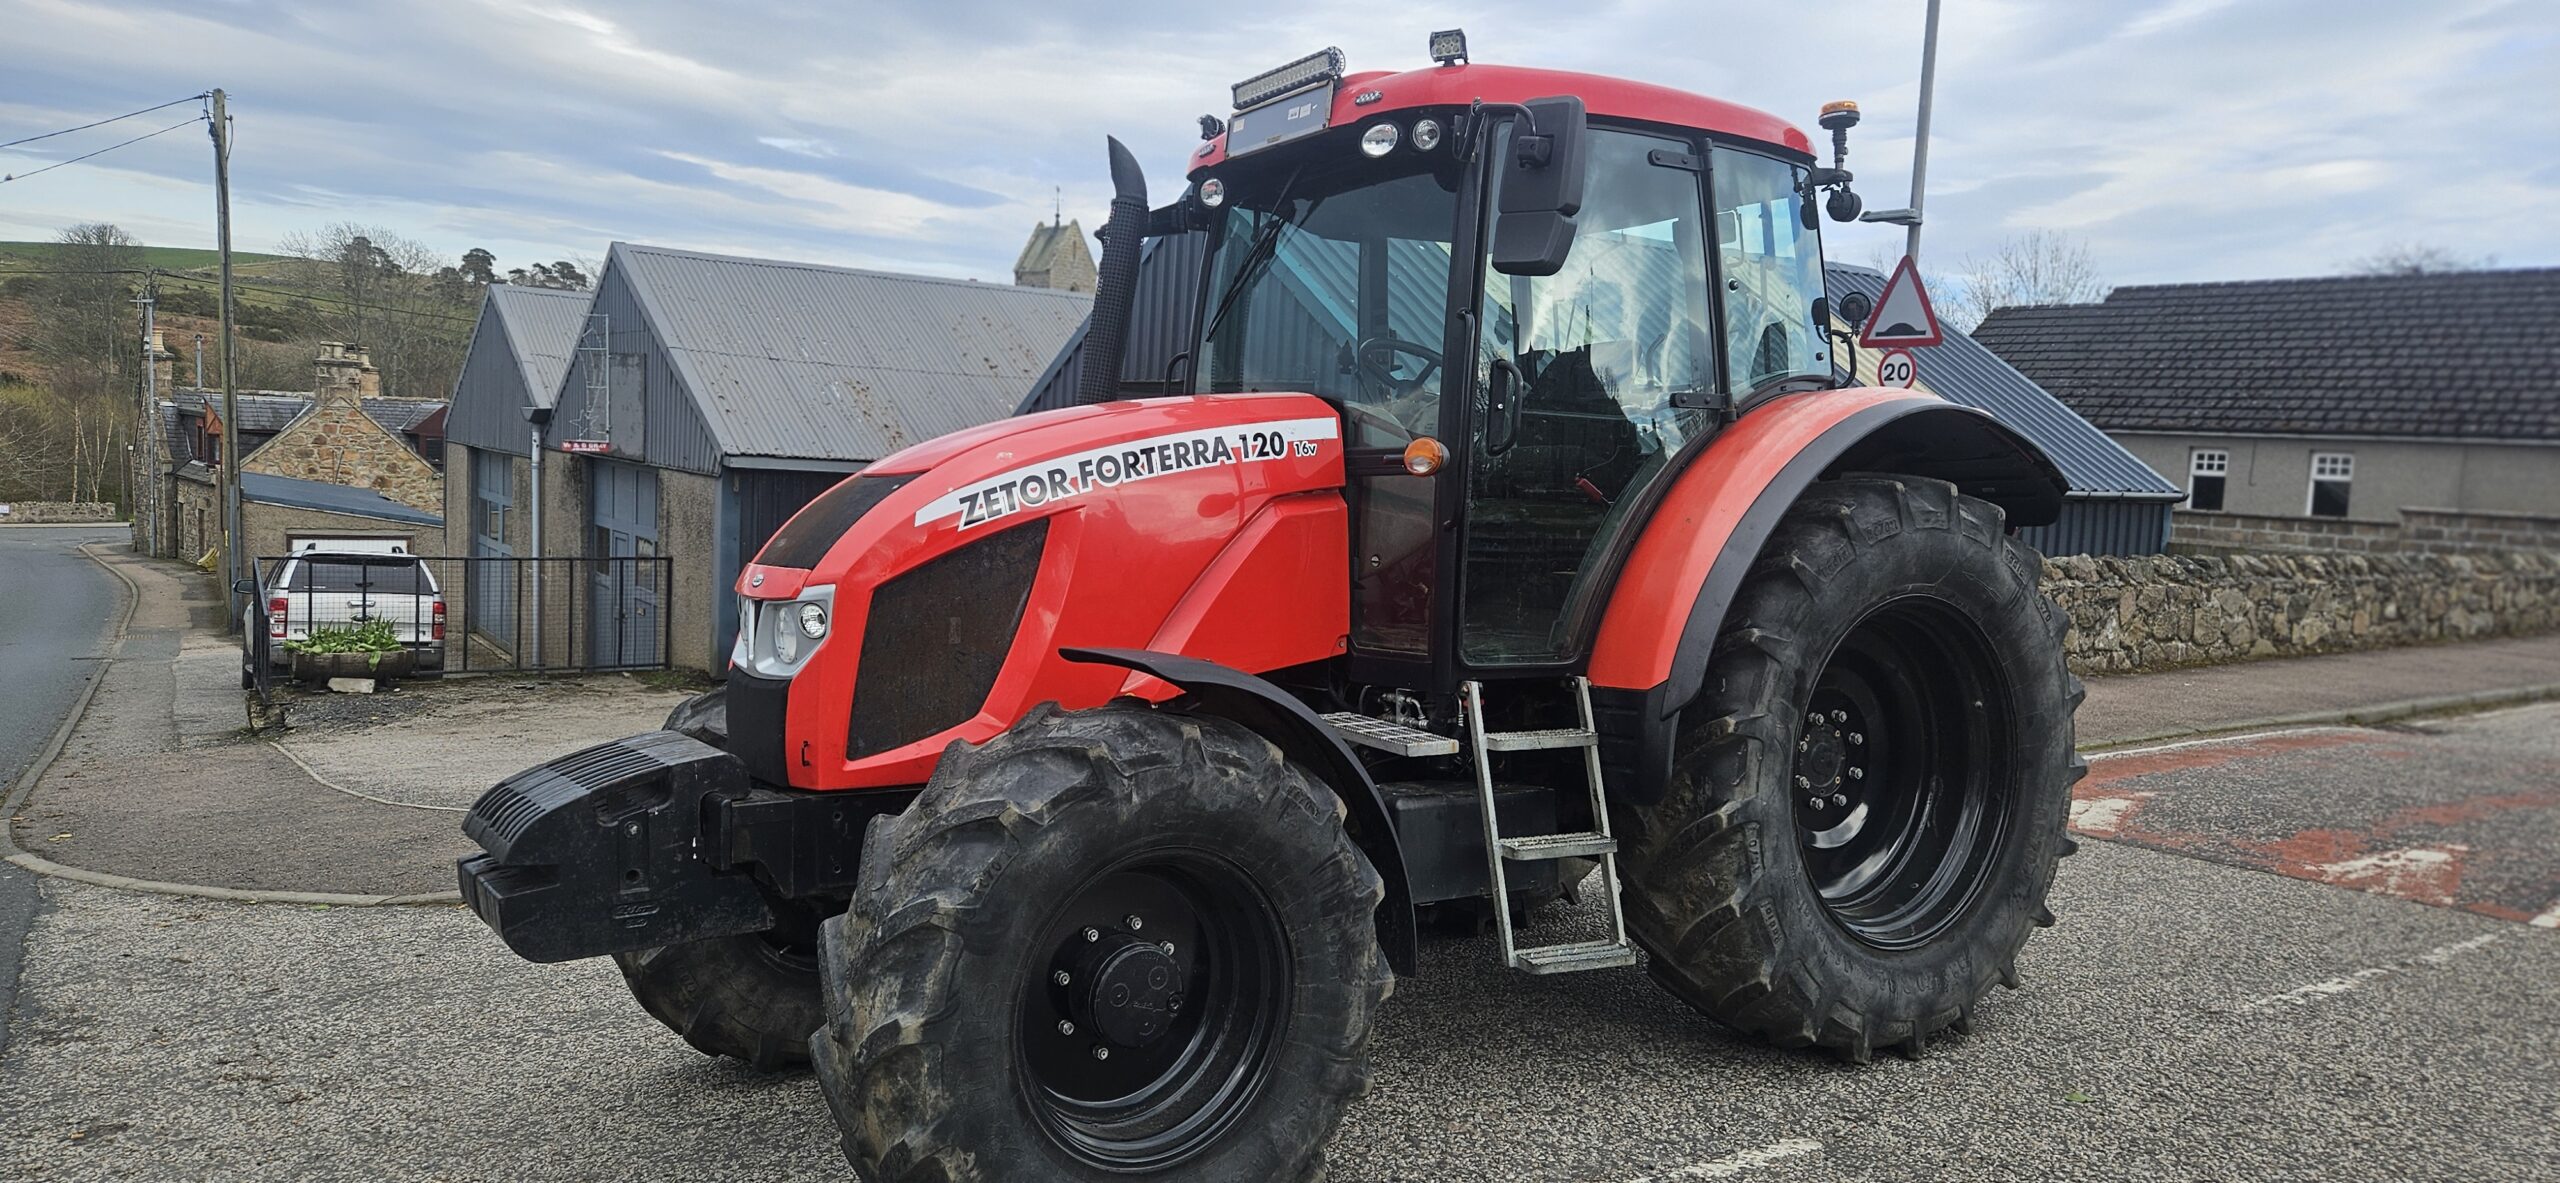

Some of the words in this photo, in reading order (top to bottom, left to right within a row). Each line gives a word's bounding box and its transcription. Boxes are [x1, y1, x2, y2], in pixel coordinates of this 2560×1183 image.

[1883, 362, 1911, 382] 20
[958, 467, 1073, 527] ZETOR
[1078, 436, 1233, 489] FORTERRA
[1238, 431, 1285, 459] 120
[1294, 441, 1317, 456] 16v
